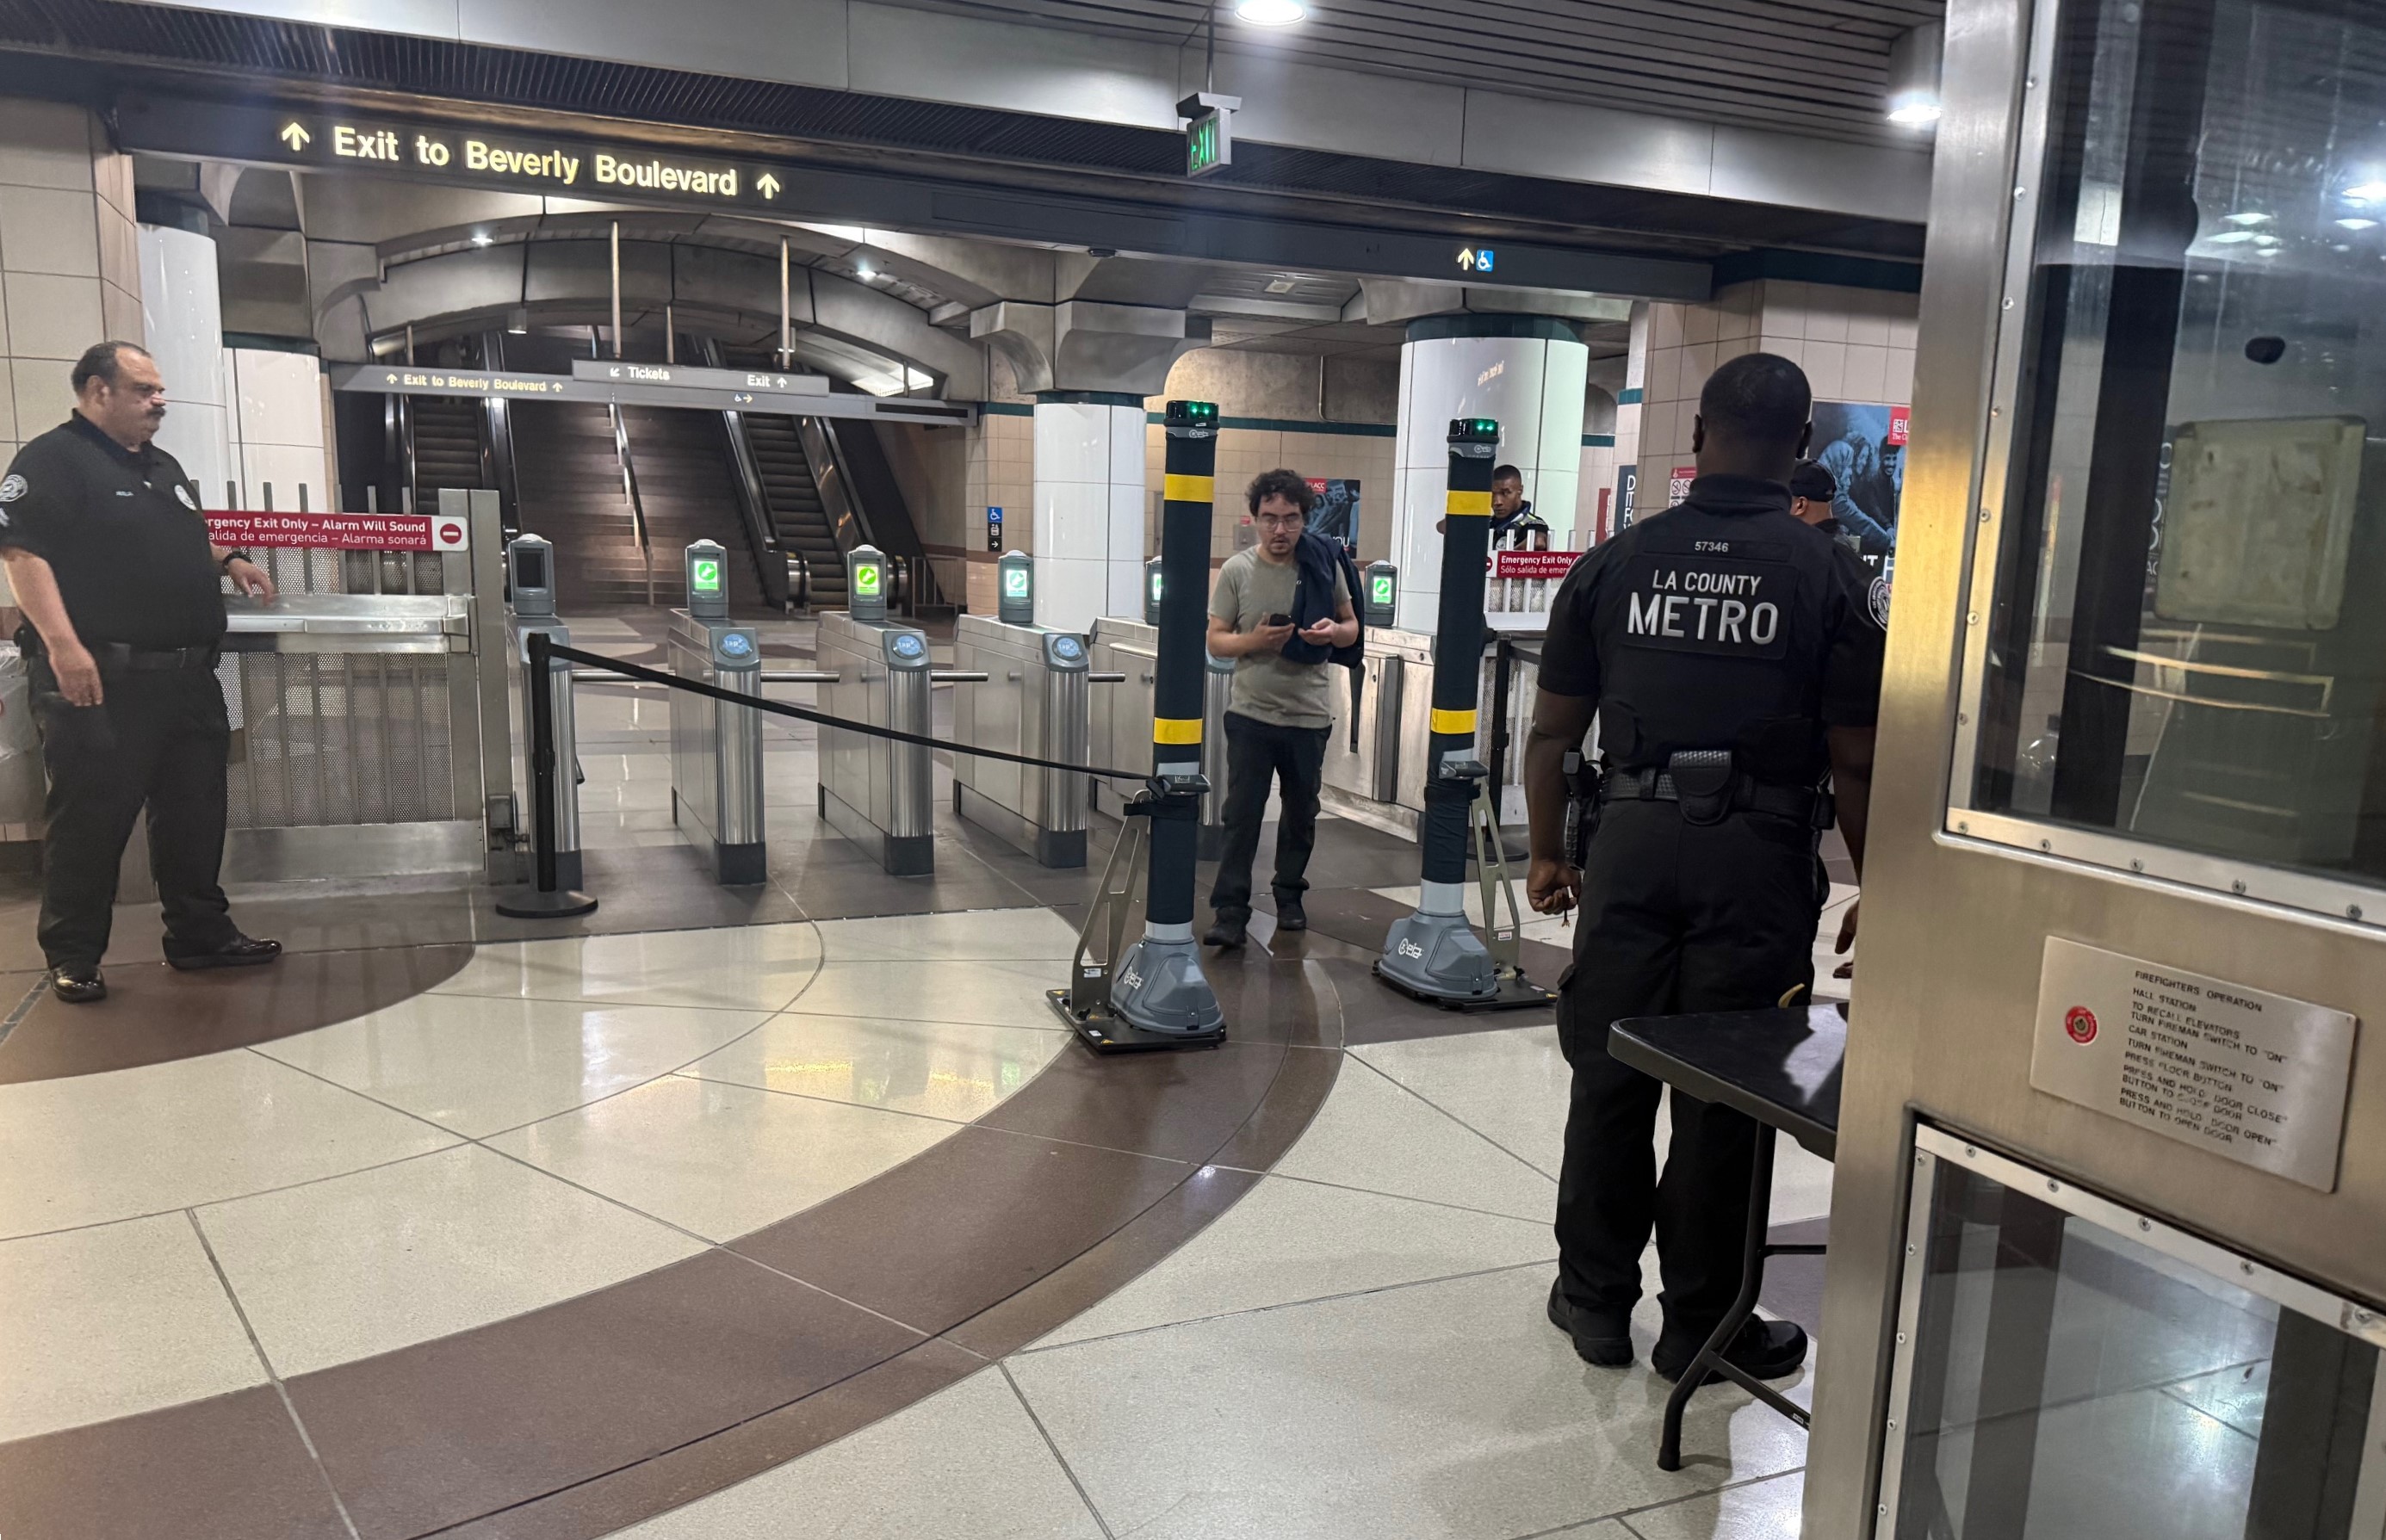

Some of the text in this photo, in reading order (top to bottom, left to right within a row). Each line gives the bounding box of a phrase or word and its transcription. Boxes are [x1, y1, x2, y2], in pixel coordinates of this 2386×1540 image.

[333, 127, 738, 196] Exit to Beverly Boulevard
[404, 374, 547, 392] Exit to Beverly Boulevard
[628, 367, 771, 387] Tickets Exit
[205, 518, 251, 529] rgency
[254, 517, 278, 528] Exit
[282, 518, 308, 531] Only
[322, 519, 360, 530] Alarm
[363, 520, 387, 531] Will
[389, 521, 425, 532] Sound
[208, 530, 237, 541] alida
[240, 530, 255, 541] de
[258, 531, 328, 544] emergencia
[342, 533, 384, 544] Alarma
[387, 535, 426, 545] sonará
[1695, 541, 1729, 553] 57346
[1500, 565, 1515, 573] Sólo
[1517, 566, 1537, 574] salida
[1501, 555, 1572, 566] Emergency Exit Only
[1652, 569, 1762, 596] LA COUNTY
[1627, 592, 1779, 645] METRO
[2133, 987, 2197, 1011] HALL STATION
[2135, 970, 2263, 1012] FIREFIGHTERS OPERATION
[2131, 1011, 2154, 1024] TURN
[2159, 1018, 2199, 1038] FIREMAN
[2203, 1032, 2240, 1050] SWITCH
[2245, 1044, 2258, 1055] TO
[2133, 1001, 2240, 1040] TO RECALL ELEVATORS
[2129, 1024, 2188, 1049] CAR STATION
[2125, 1050, 2232, 1092] PRESS FLOOR BUTTON
[2129, 1037, 2151, 1052] TURN
[2155, 1046, 2196, 1067] FIREMAN
[2199, 1061, 2236, 1079] SWITCH
[2240, 1073, 2253, 1084] TO
[2122, 1073, 2158, 1092] BUTTON
[2162, 1087, 2174, 1098] TO
[2123, 1064, 2153, 1081] PRESS
[2157, 1076, 2176, 1088] AND
[2121, 1087, 2150, 1104] PRESS
[2154, 1099, 2172, 1111] AND
[2120, 1097, 2232, 1144] BUTTON TO OPEN DOOR
